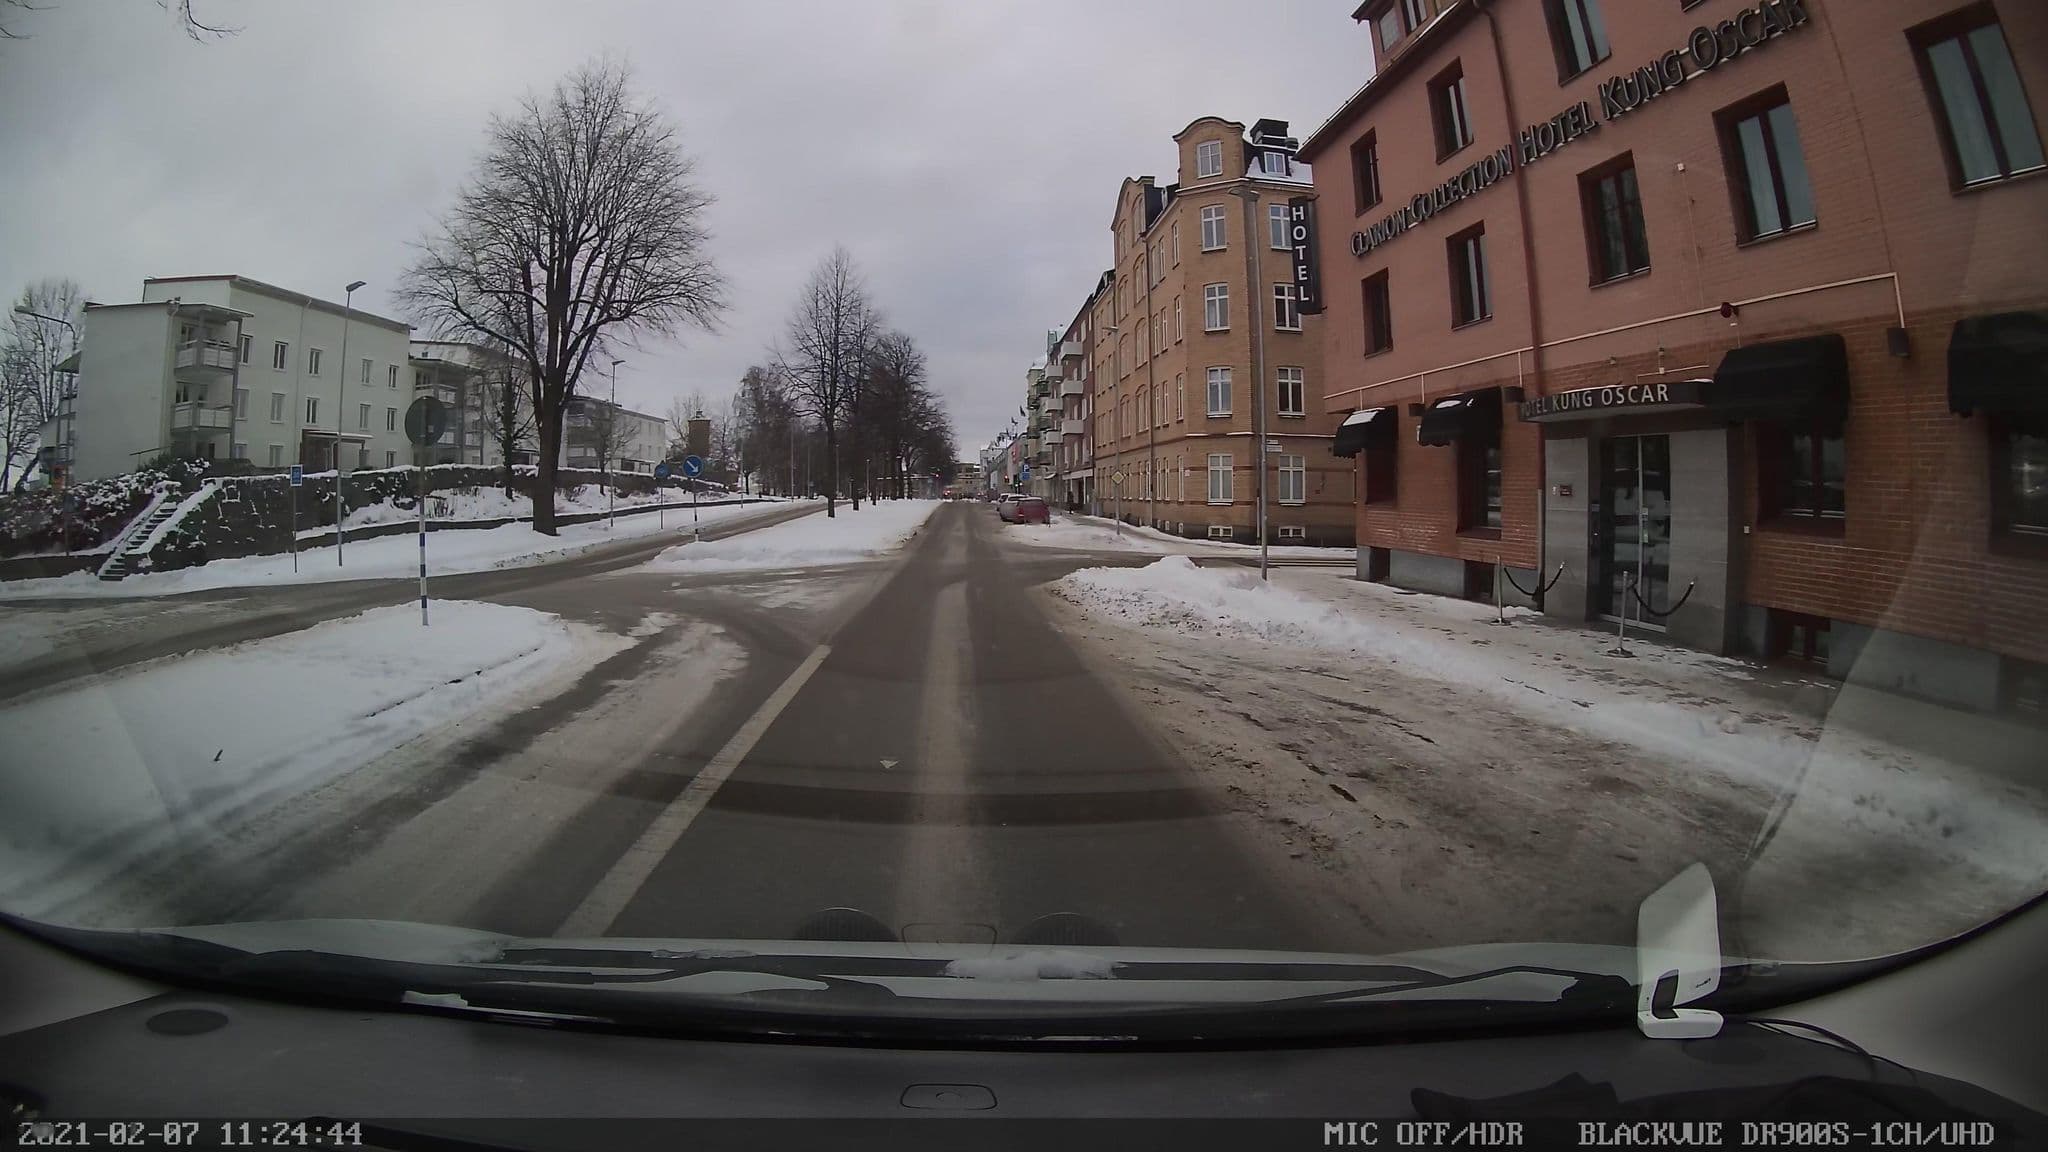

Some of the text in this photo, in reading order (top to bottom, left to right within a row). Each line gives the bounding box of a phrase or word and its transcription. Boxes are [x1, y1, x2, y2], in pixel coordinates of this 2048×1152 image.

[1351, 0, 1807, 257] CLARION COLLECTION HOTEL KUNG OSCAR
[1292, 206, 1309, 301] HOTEL
[1520, 384, 1669, 417] HOTEL KUNG OSCAR
